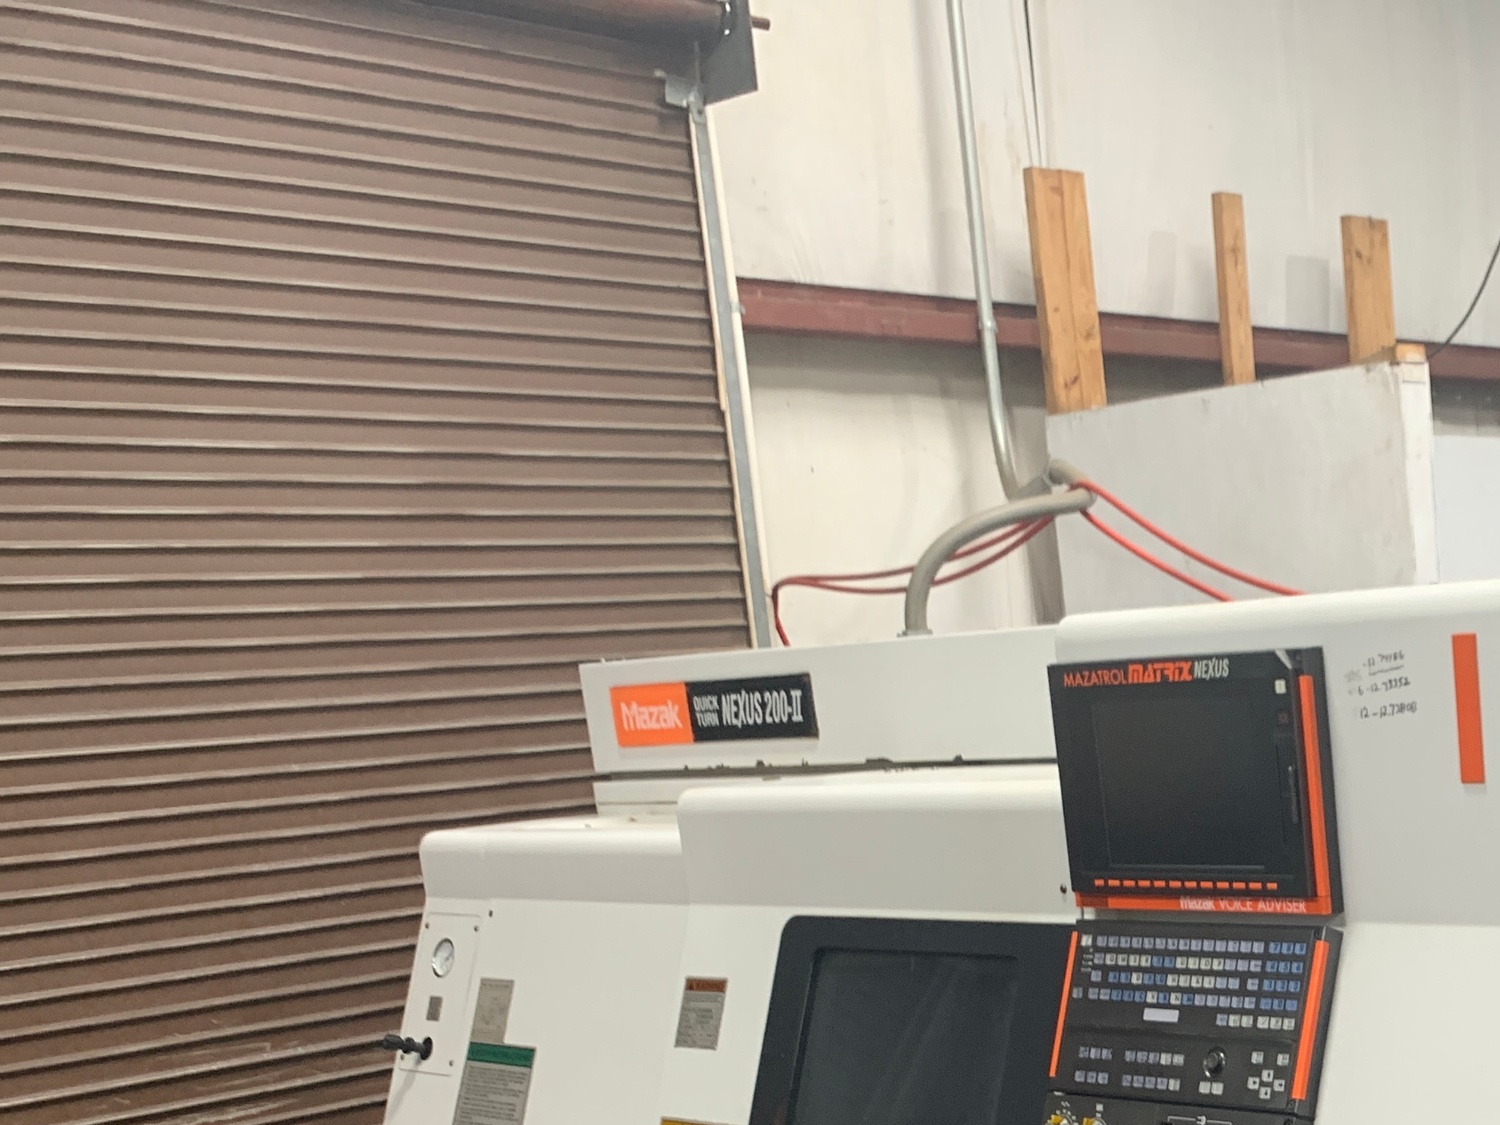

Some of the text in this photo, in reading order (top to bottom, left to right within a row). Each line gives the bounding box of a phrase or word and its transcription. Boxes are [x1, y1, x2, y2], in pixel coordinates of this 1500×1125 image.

[1063, 657, 1229, 688] MAZATROL MATRIX NEXUS
[693, 695, 720, 711] QUICK
[721, 690, 763, 728] NEXUS
[619, 700, 683, 731] Mazak
[695, 711, 720, 727] TURN
[1219, 896, 1253, 911] VOICE
[1257, 897, 1307, 913] ADVISER
